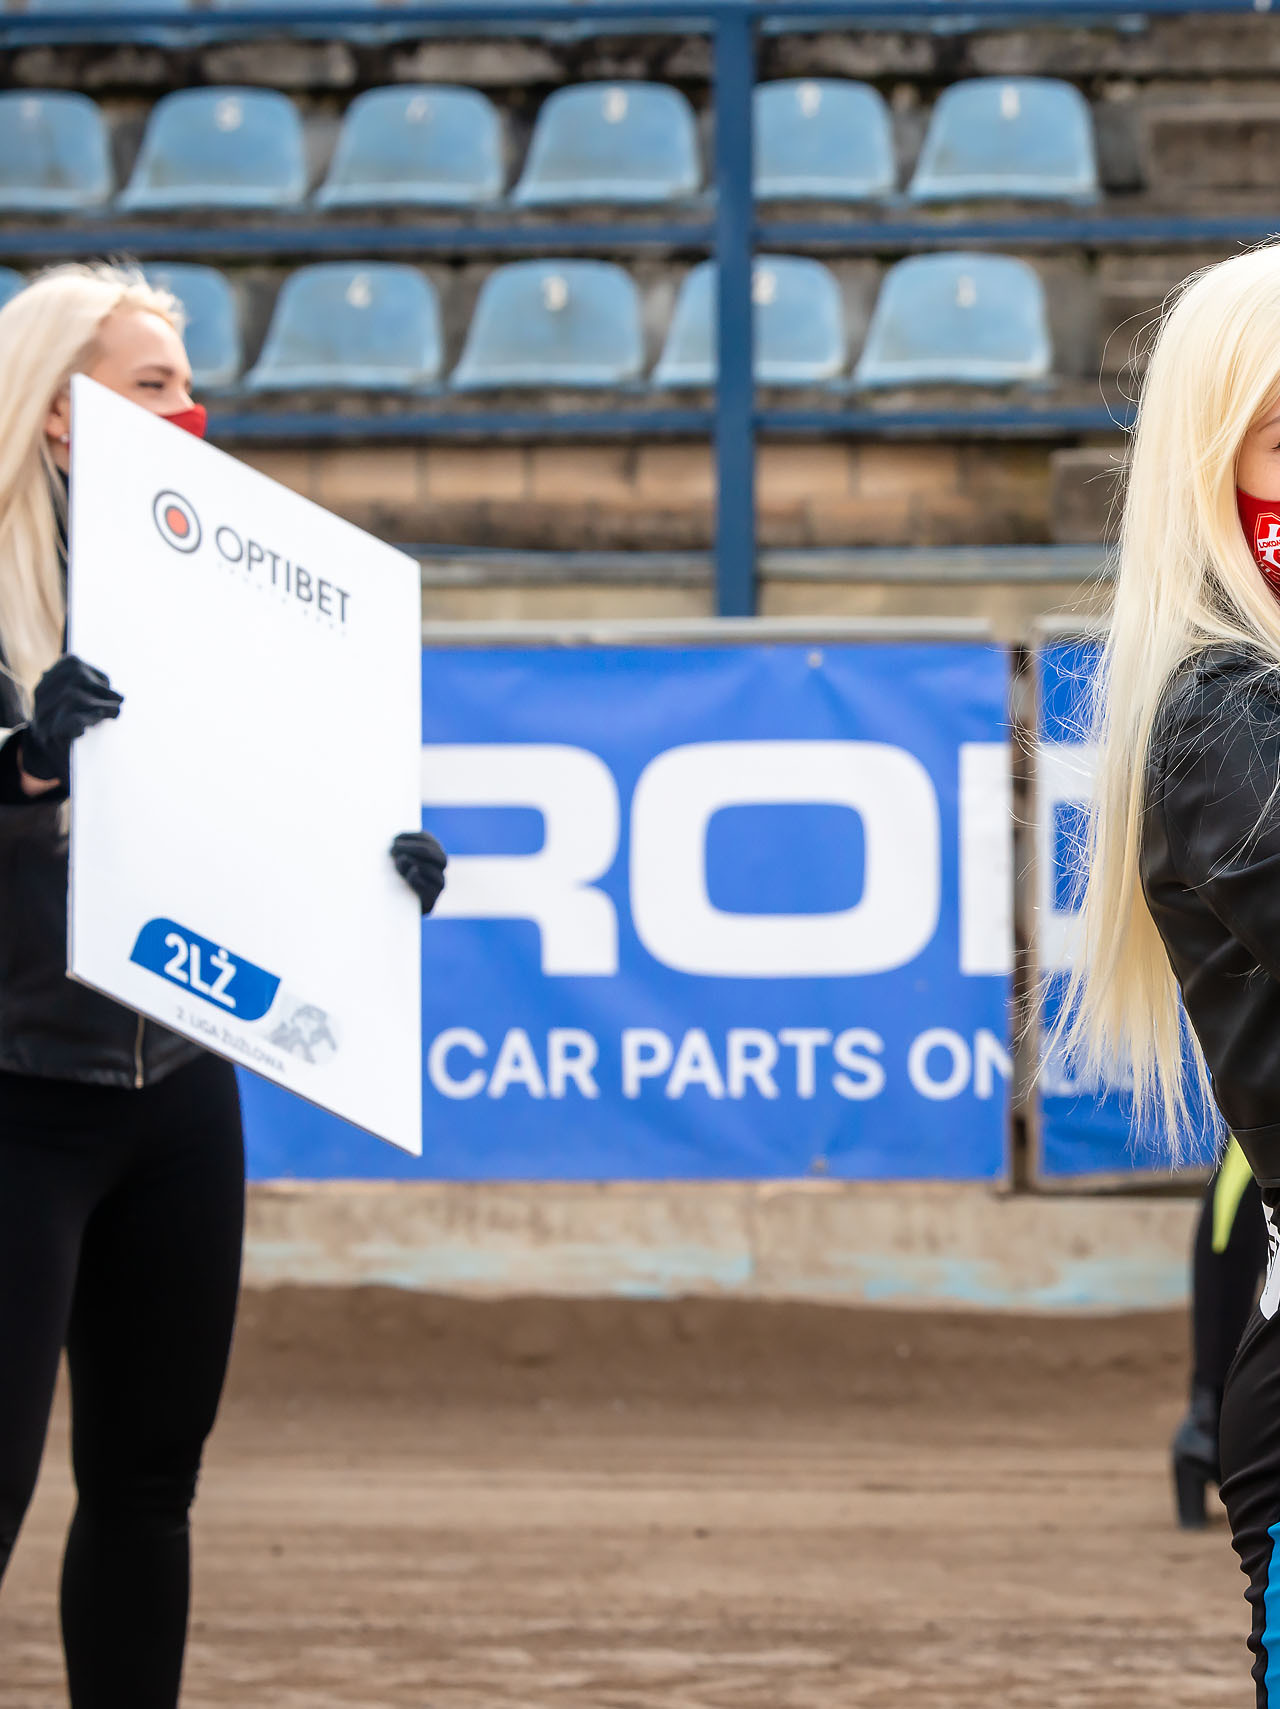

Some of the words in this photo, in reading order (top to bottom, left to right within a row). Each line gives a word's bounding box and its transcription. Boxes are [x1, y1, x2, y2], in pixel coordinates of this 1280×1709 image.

[215, 526, 350, 623] OPTIBET
[163, 931, 237, 1009] 2LŻ
[428, 1027, 599, 1101] CAR
[621, 1027, 886, 1101] PARTS
